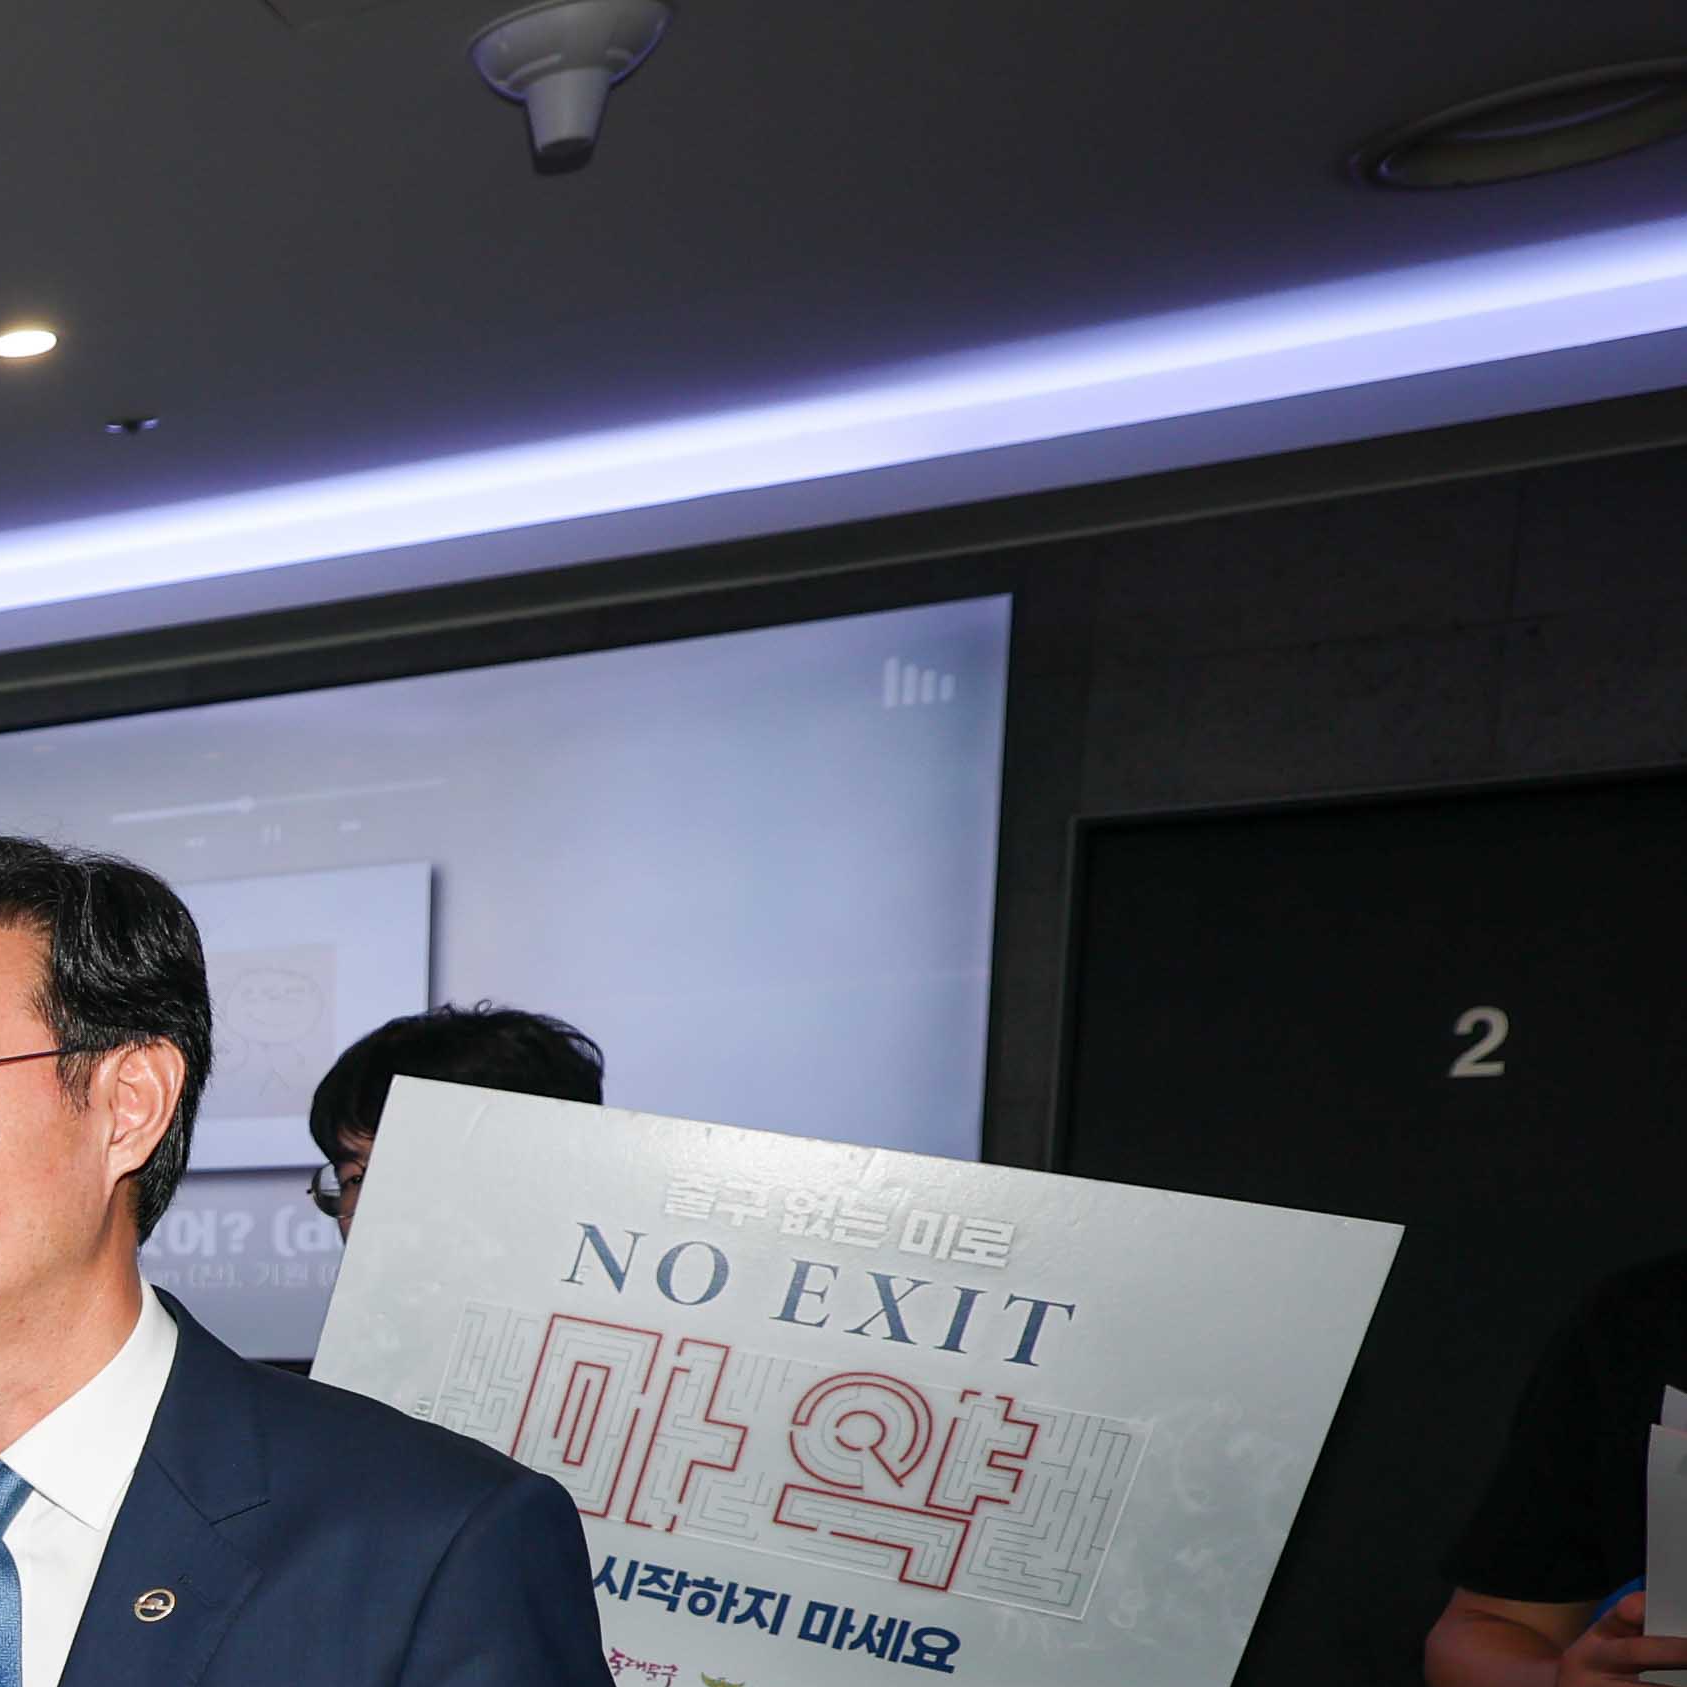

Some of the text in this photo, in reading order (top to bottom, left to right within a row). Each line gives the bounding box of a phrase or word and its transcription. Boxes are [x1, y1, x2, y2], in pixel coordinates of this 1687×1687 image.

[1447, 1005, 1510, 1078] 2
[779, 1187, 891, 1249] 없는
[898, 1208, 1016, 1269] 미로
[561, 1222, 1077, 1367] NO EXIT
[592, 1555, 962, 1674] 시작하지 마세요
